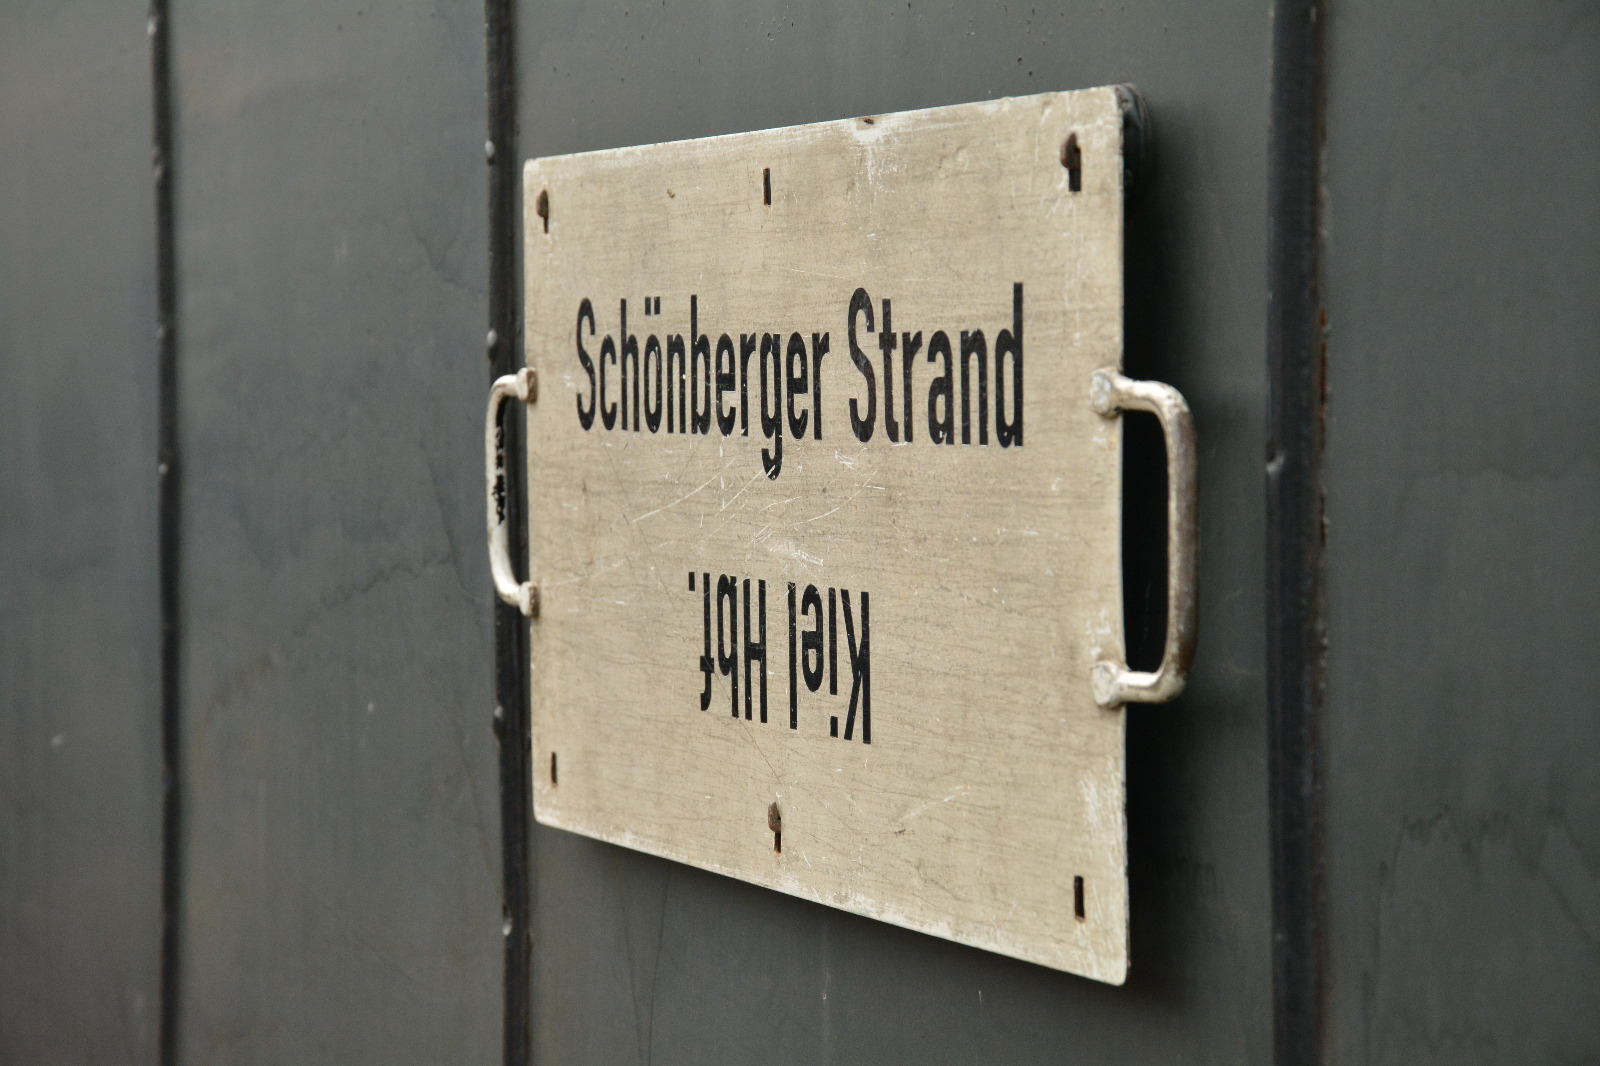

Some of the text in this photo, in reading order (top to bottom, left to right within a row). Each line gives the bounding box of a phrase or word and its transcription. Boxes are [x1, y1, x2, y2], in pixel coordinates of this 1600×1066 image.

[576, 282, 1024, 481] Schönberger Strand
[688, 571, 872, 745] Kiel Hbf.
